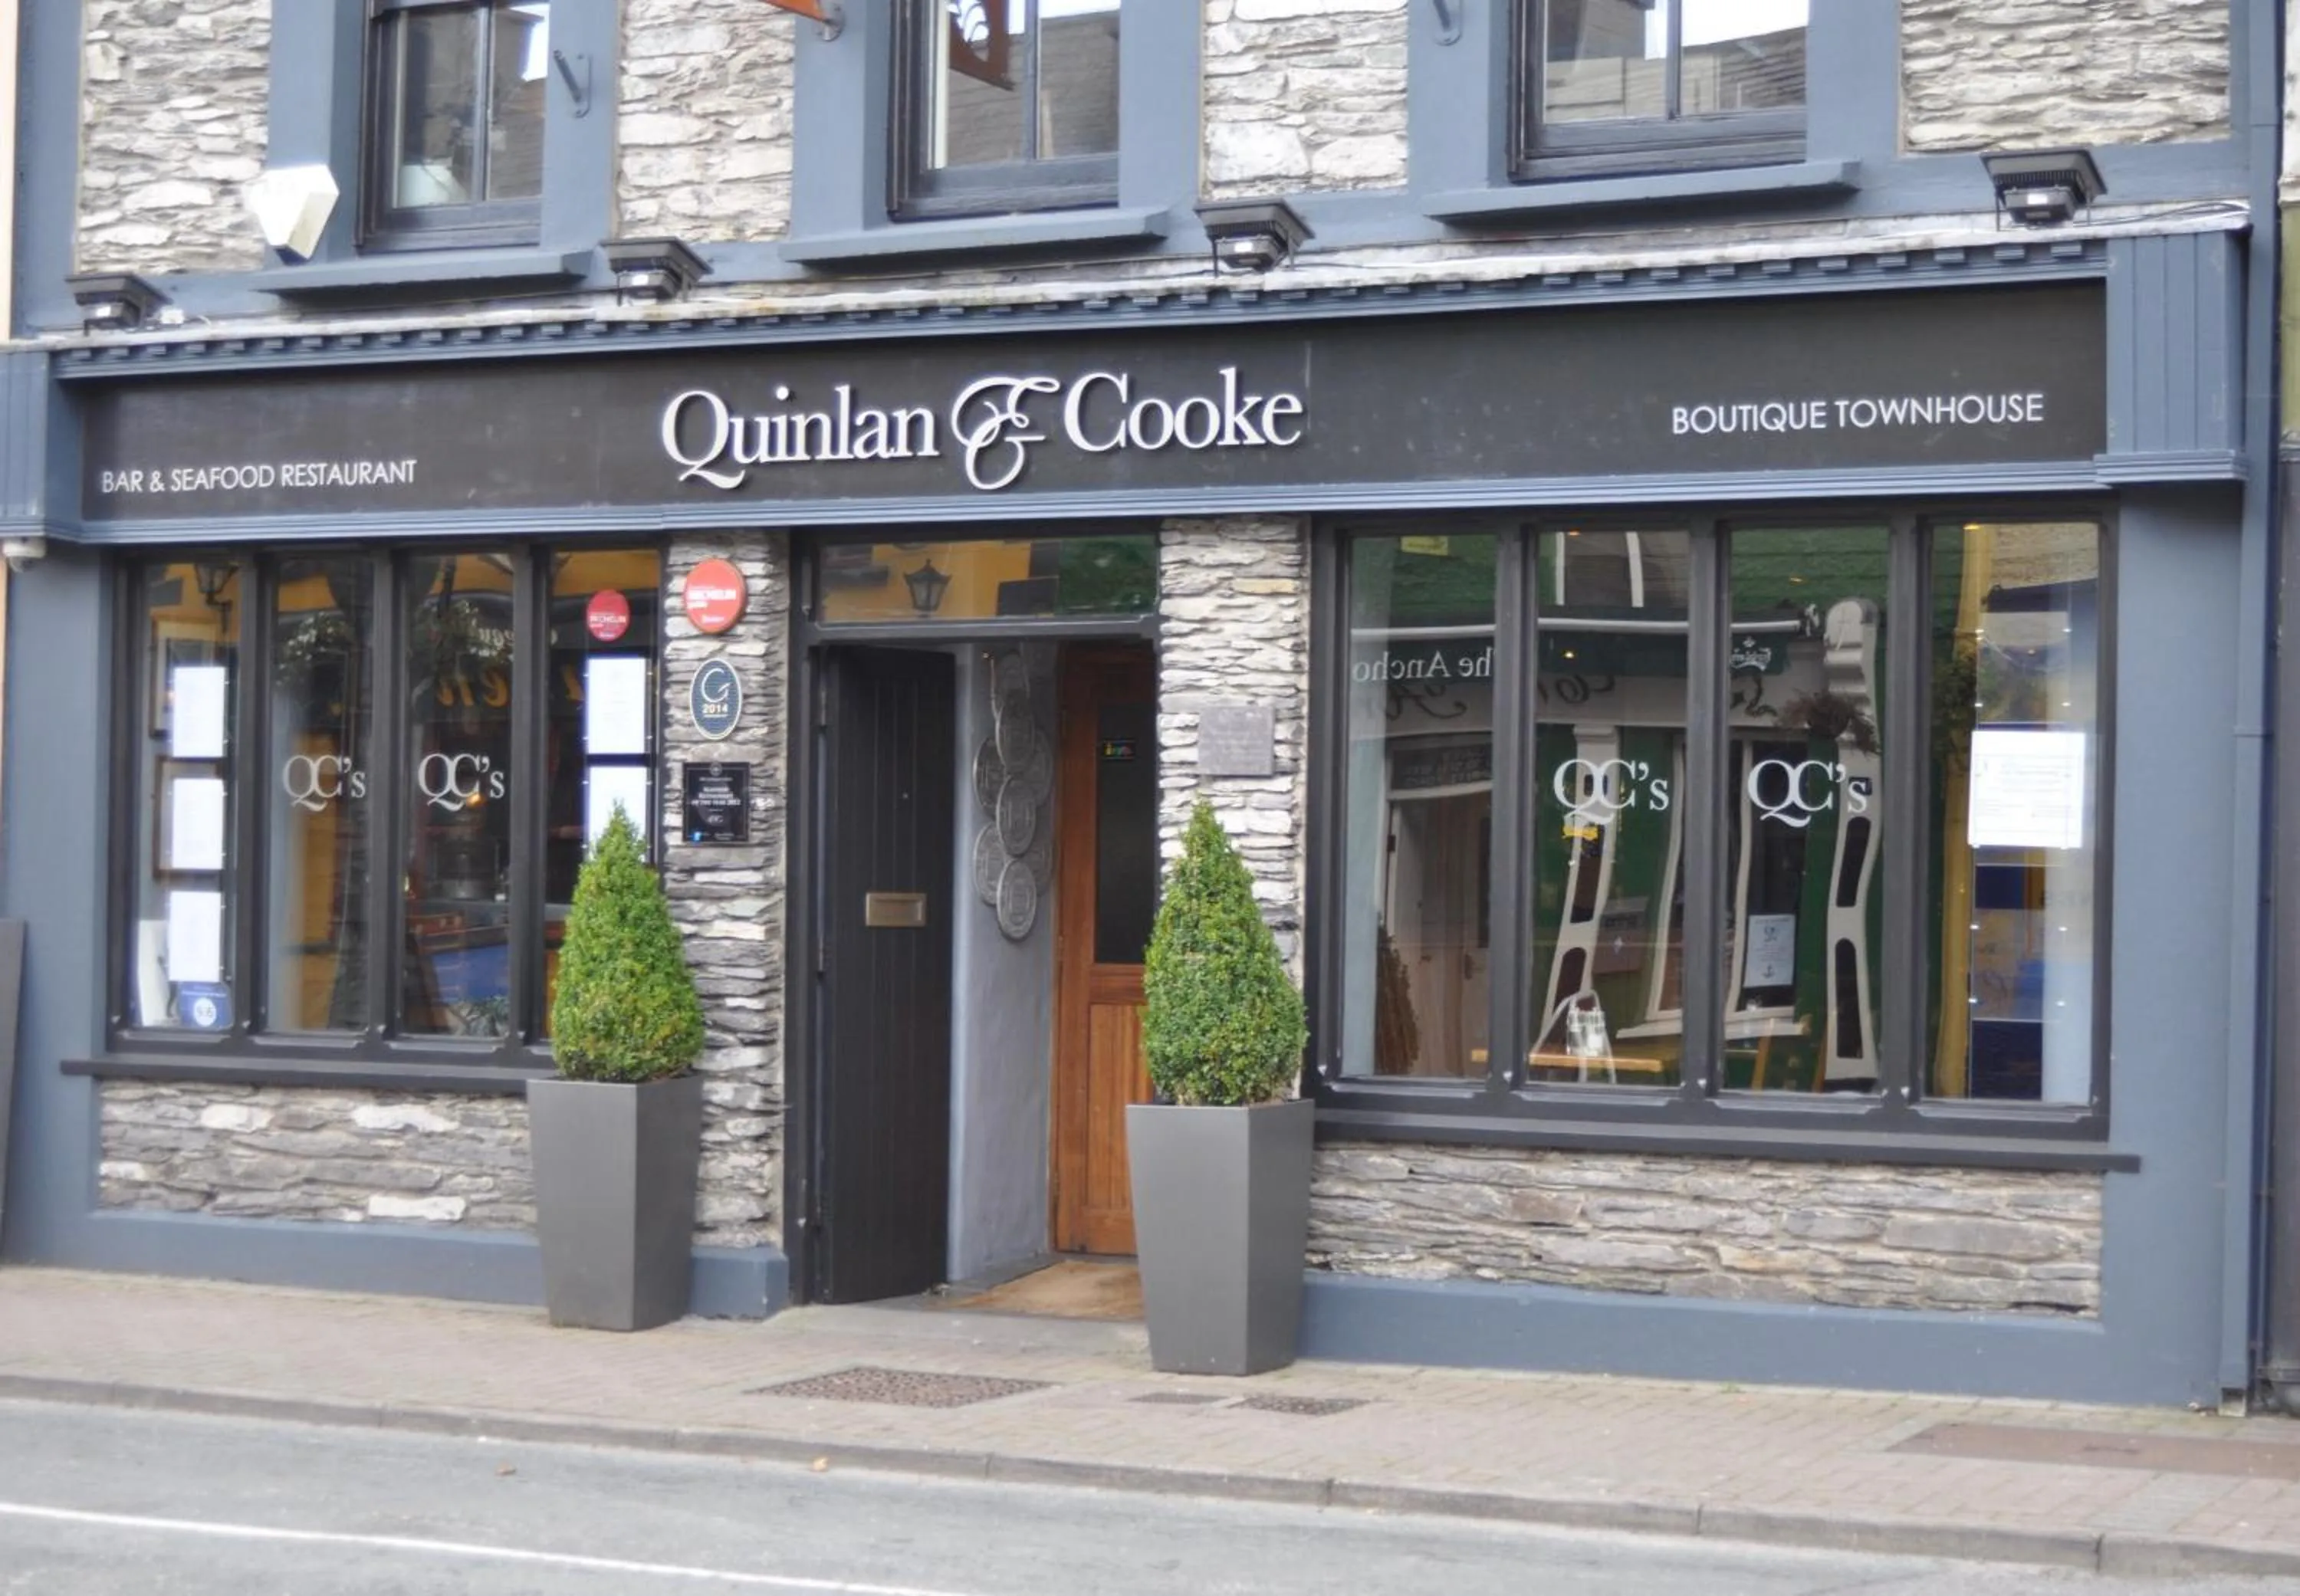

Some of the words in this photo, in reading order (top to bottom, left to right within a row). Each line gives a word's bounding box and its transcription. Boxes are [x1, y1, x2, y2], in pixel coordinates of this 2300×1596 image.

[661, 385, 940, 490] Quinlan
[1063, 366, 1303, 452] Cooke
[1671, 401, 1827, 435] BOUTIQUE
[1835, 393, 2045, 429] TOWNHOUSE
[101, 469, 143, 494] BAR
[150, 470, 169, 492] &
[171, 465, 275, 491] SEAFOOD
[281, 458, 418, 488] RESTAURANT
[702, 703, 728, 714] 2014
[282, 754, 367, 812] QC's
[418, 753, 506, 812] QC's
[1552, 758, 1670, 825] QC's
[1746, 759, 1869, 828] QC's
